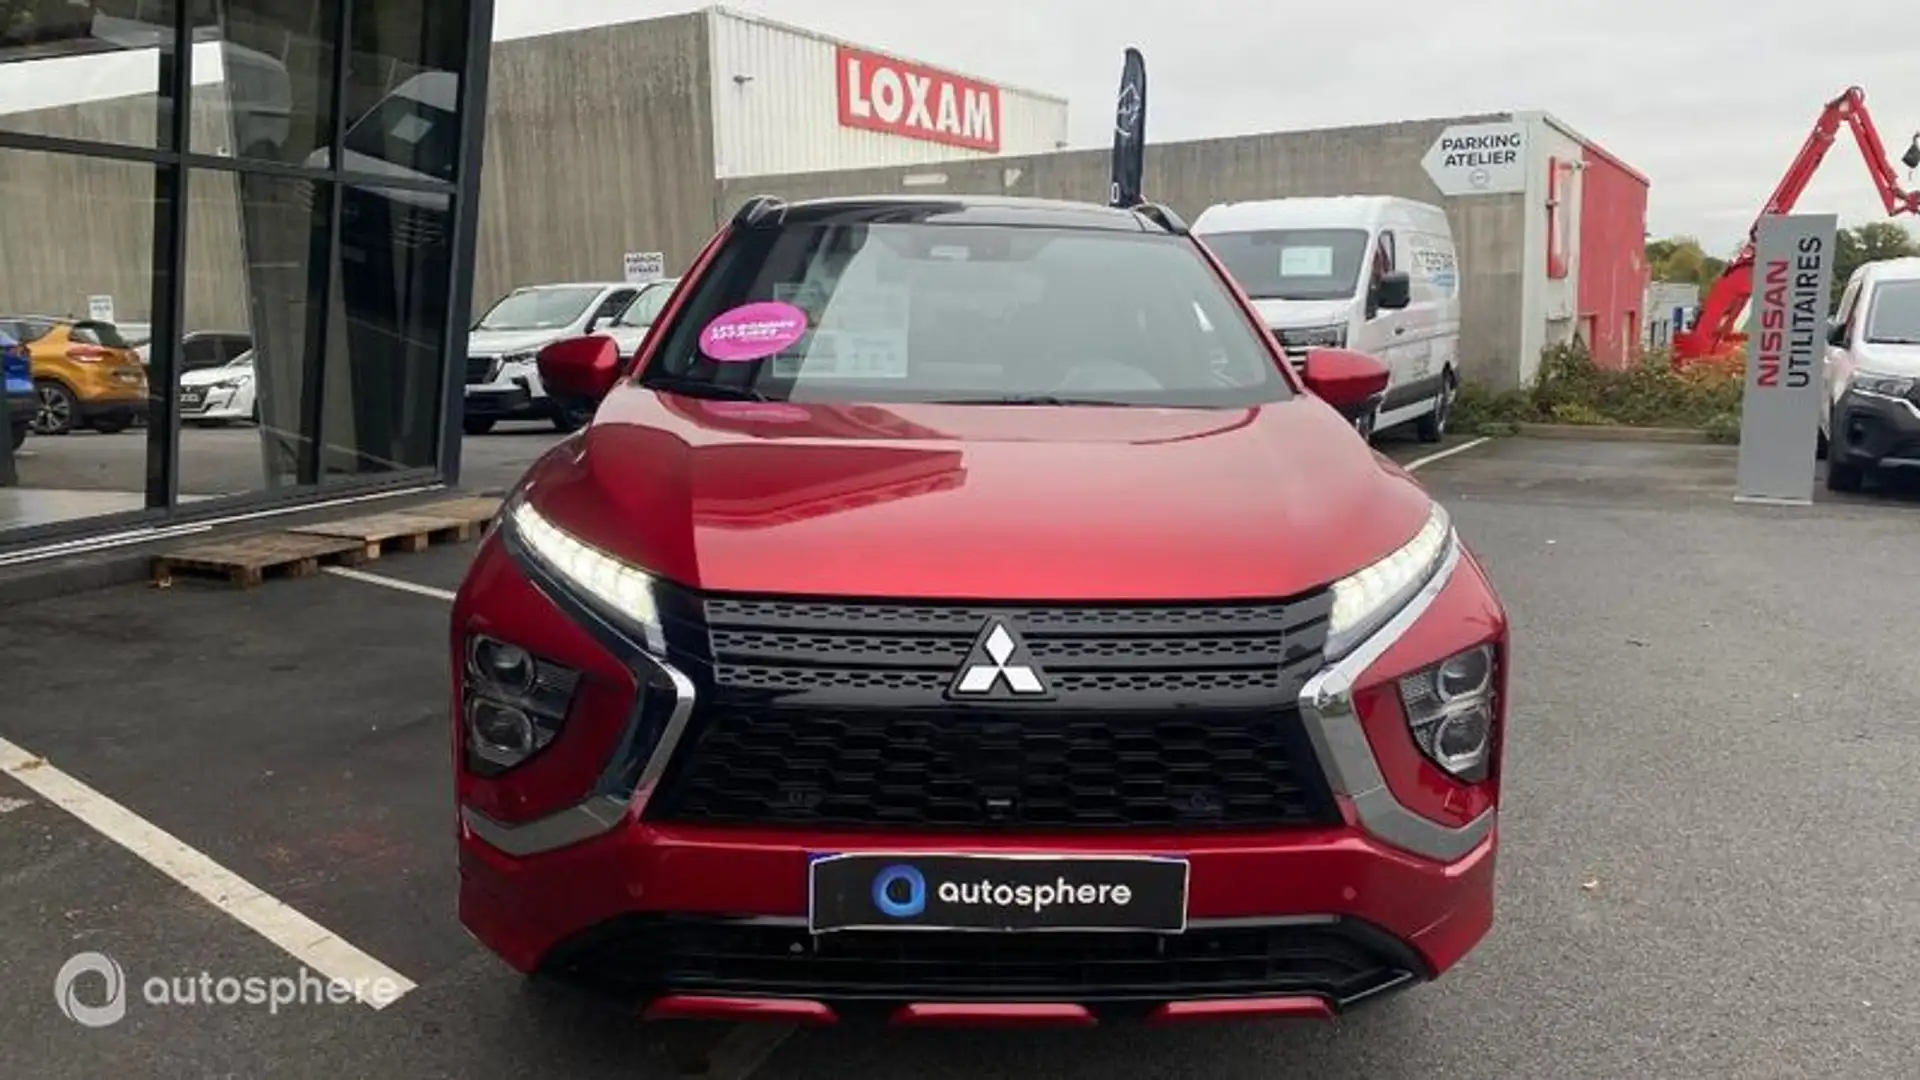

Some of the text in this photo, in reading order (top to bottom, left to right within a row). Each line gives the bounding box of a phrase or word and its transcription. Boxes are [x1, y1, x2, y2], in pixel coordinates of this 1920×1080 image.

[848, 58, 993, 143] LOXAM
[1442, 133, 1520, 150] PARKING
[1444, 151, 1516, 166] ATELIER
[1757, 261, 1790, 388] NISSAN
[1786, 236, 1822, 388] UTILITAIRES
[938, 876, 1132, 913] autosphere
